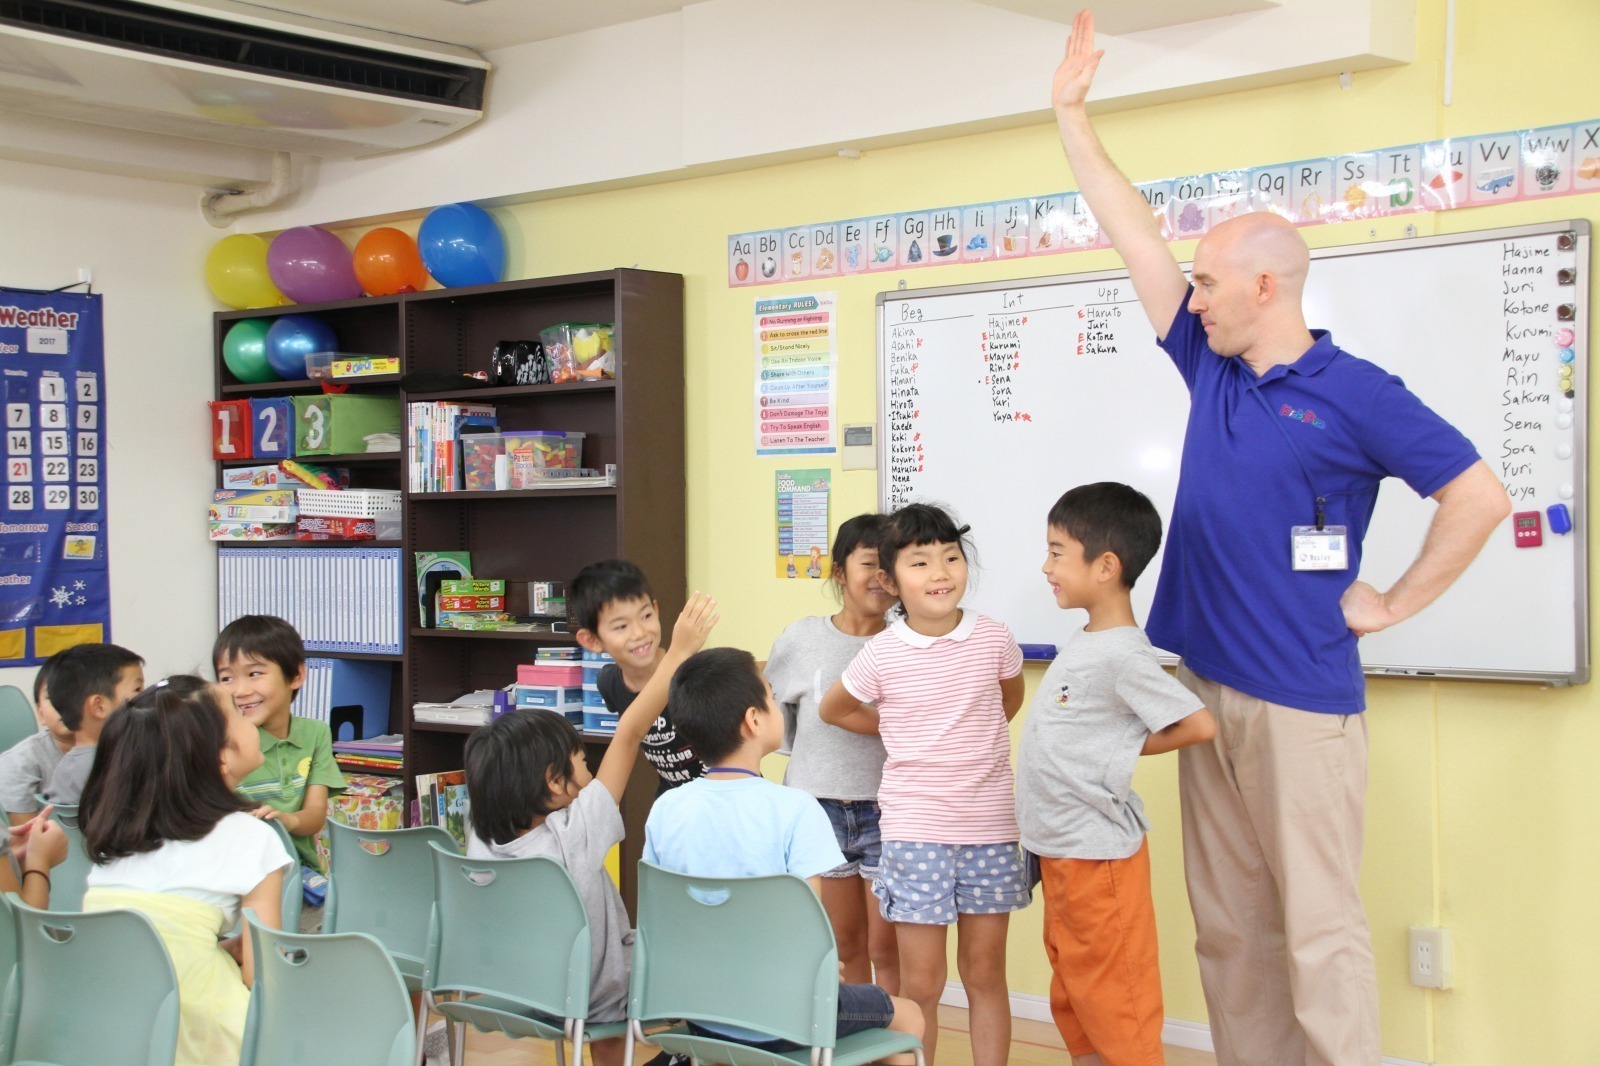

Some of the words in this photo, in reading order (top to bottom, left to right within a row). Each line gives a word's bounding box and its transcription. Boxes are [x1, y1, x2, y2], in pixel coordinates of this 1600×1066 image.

[733, 240, 751, 256] Aa
[760, 237, 776, 252] Bb
[789, 233, 805, 248] Cc
[816, 227, 834, 246] Dd
[846, 226, 861, 242] Ee
[876, 220, 890, 243] Ff
[904, 218, 924, 238] Gg
[934, 212, 956, 231] Hh
[975, 210, 984, 228] Ii
[1005, 206, 1018, 229] Jj
[1258, 173, 1285, 196] Qq
[1300, 168, 1322, 186] Rr
[1343, 161, 1364, 180] Ss
[1389, 154, 1410, 174] Tt
[1480, 141, 1512, 162] Vv
[1582, 127, 1600, 150] X
[1503, 242, 1550, 260] Hajime
[1502, 264, 1544, 276] Hanna
[1503, 281, 1534, 294] Juri
[760, 304, 792, 312] Elementary
[794, 300, 814, 308] RULES!
[1003, 293, 1024, 308] Int
[902, 303, 922, 322] Beg
[1088, 306, 1122, 318] Haruto
[1504, 298, 1550, 317] Kotone
[0, 307, 78, 330] Weather
[988, 317, 1020, 330] Hajime
[1088, 320, 1108, 330] Juri
[1506, 320, 1552, 342] Kurumi
[892, 328, 915, 338] Akira
[988, 329, 1018, 340] Hanna
[1078, 332, 1084, 343] E
[892, 340, 914, 350] Asahi
[990, 340, 1020, 350] Kurumi
[1077, 345, 1084, 355] E
[1086, 342, 1118, 354] Sakura
[891, 352, 918, 362] Benika
[990, 353, 1013, 364] Mayu
[1502, 347, 1540, 367] Mayu
[890, 364, 910, 374] Fuka
[891, 374, 916, 386] Himari
[992, 374, 1011, 385] Sena
[1506, 367, 1538, 386] Rin
[50, 384, 56, 396] 1
[84, 384, 91, 396] 2
[891, 386, 920, 398] Hinata
[992, 385, 1012, 396] Sora
[890, 399, 914, 409] Hiroto
[992, 396, 1010, 408] Yuri
[1502, 390, 1550, 406] Sakura
[15, 409, 23, 422] 7
[50, 409, 58, 422] 8
[83, 410, 91, 423] 9
[992, 410, 1013, 424] Yuya
[1504, 412, 1542, 432] Sena
[218, 411, 235, 453] 1
[260, 407, 278, 451] 2
[304, 405, 324, 448] 3
[892, 422, 912, 430] Kaede
[12, 437, 27, 450] 14
[46, 437, 63, 449] 15
[81, 438, 94, 450] 16
[892, 433, 906, 442] Koki
[892, 444, 916, 453] Kokoro
[1500, 438, 1536, 458] Sora
[892, 454, 915, 465] Koyuri
[13, 463, 28, 476] 21
[47, 462, 66, 475] 22
[80, 464, 95, 476] 23
[1502, 462, 1532, 478] Yuri
[13, 491, 30, 504] 28
[49, 490, 67, 503] 29
[80, 491, 96, 504] 30
[66, 523, 98, 532] Season
[666, 749, 693, 762] CLUB
